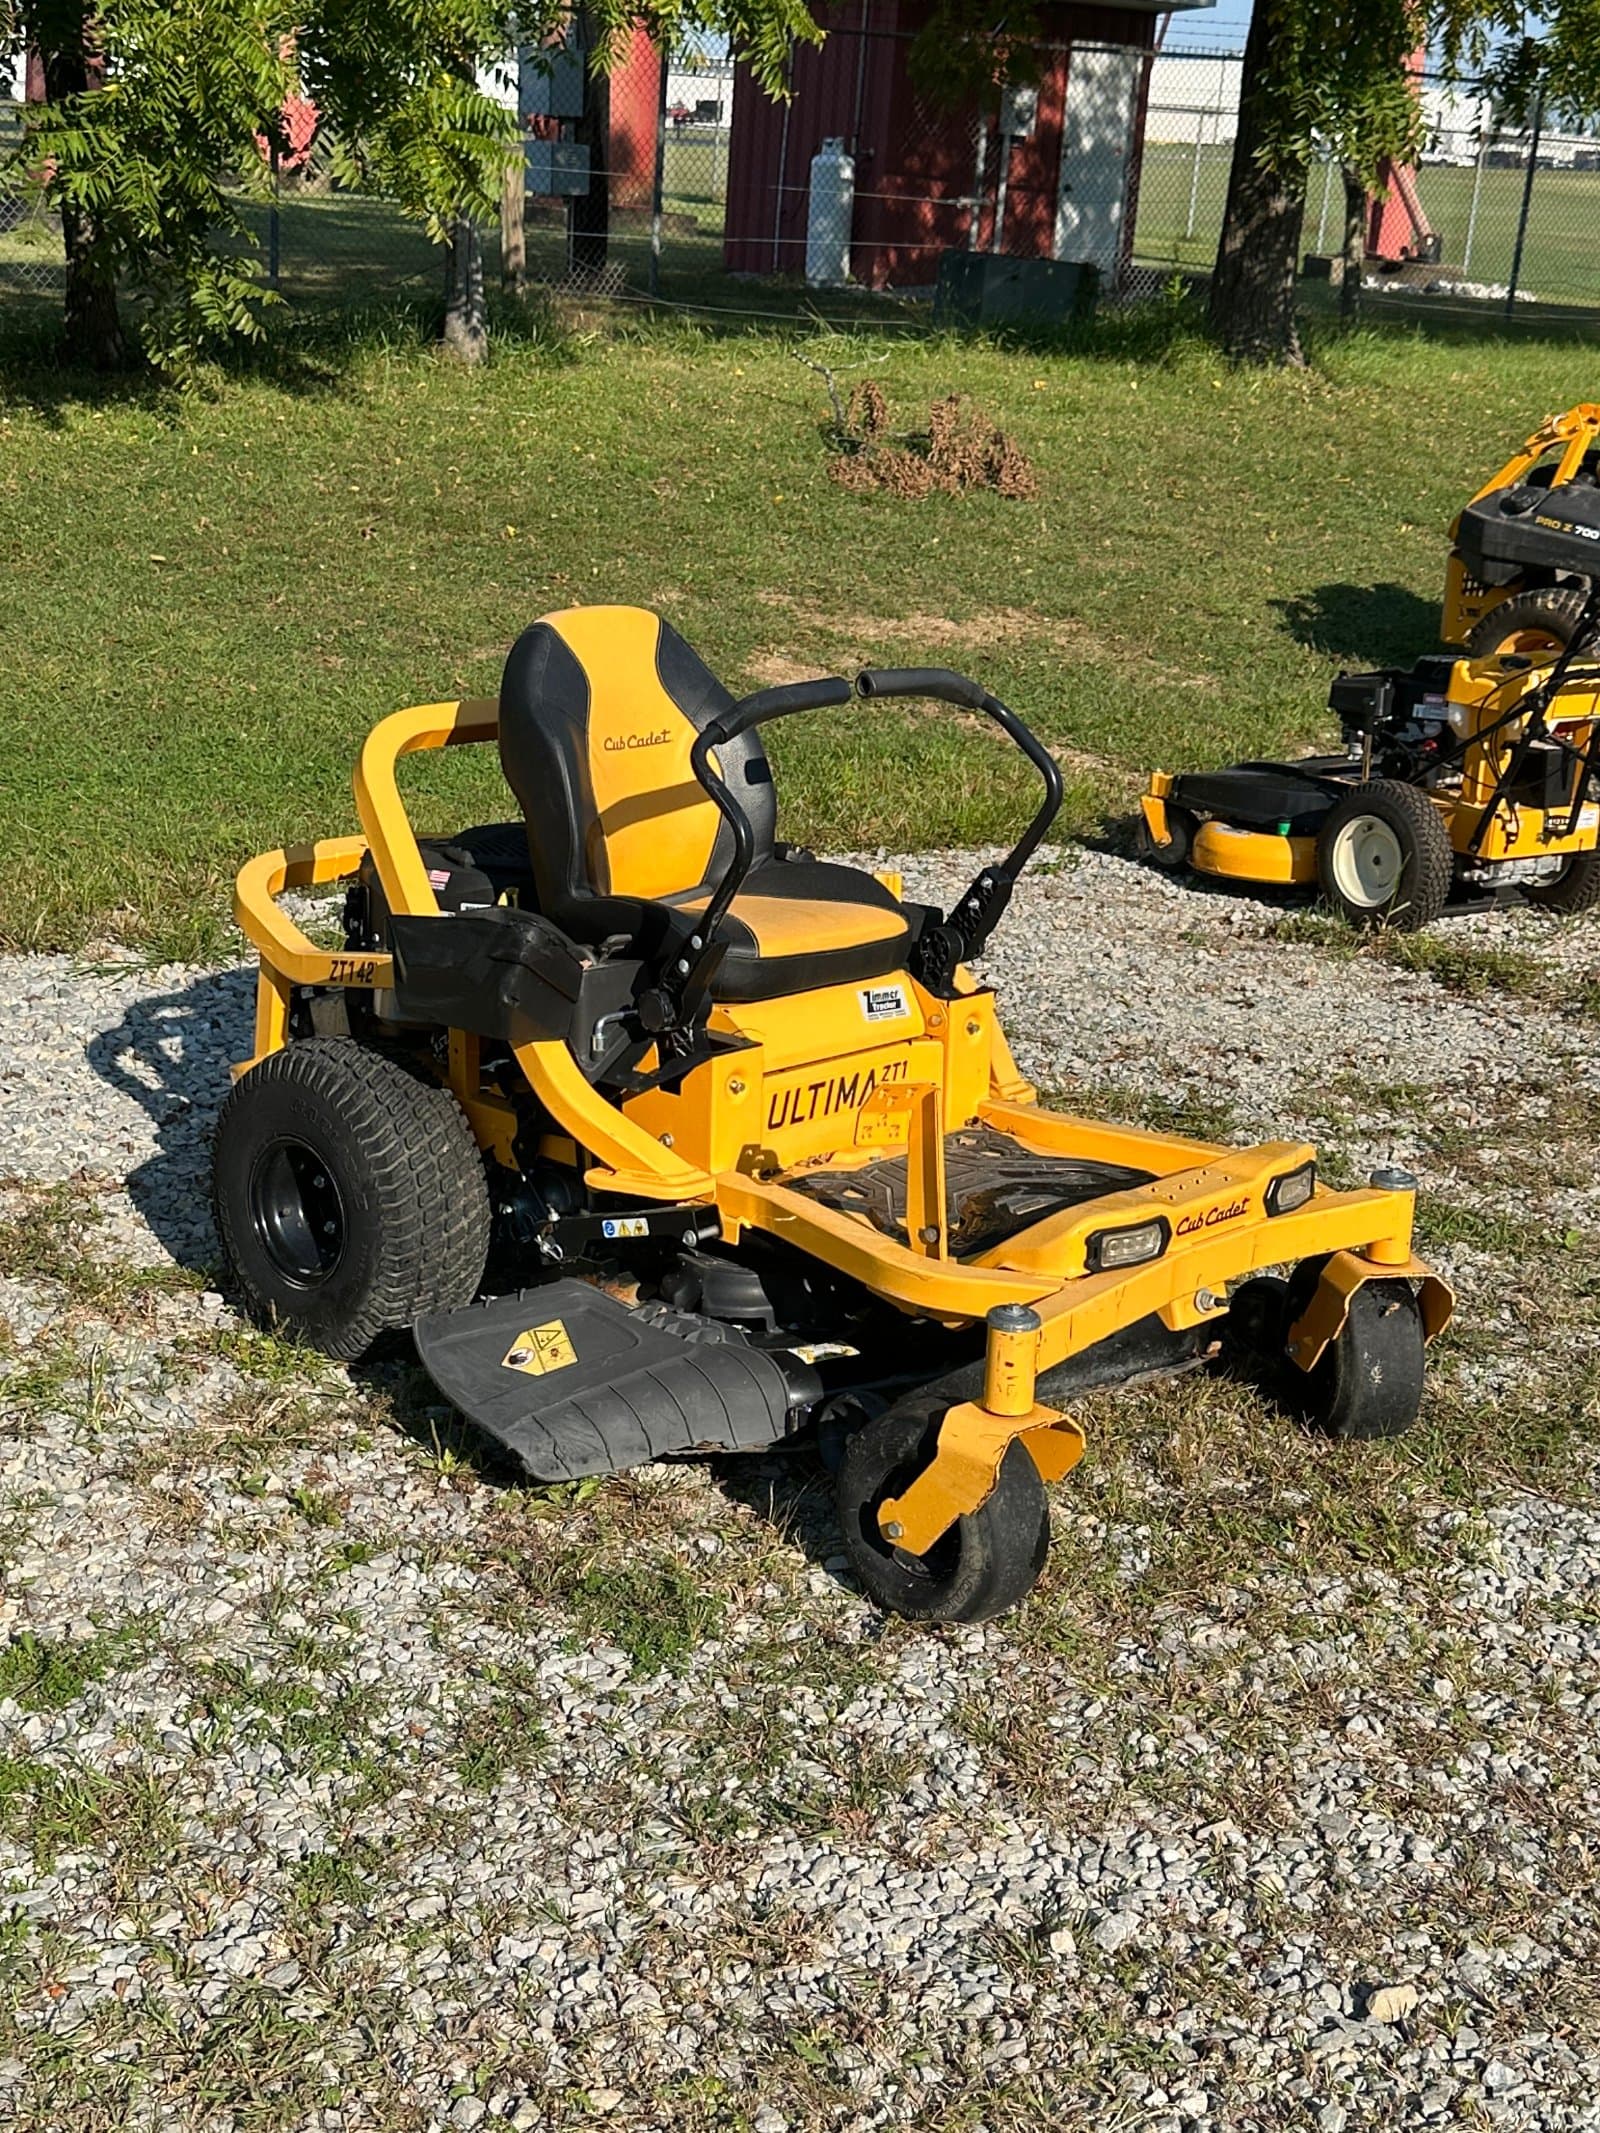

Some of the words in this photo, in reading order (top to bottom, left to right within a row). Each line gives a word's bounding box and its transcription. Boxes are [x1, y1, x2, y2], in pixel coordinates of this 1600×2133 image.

[1535, 514, 1561, 529] PRO
[1563, 522, 1573, 533] Z
[1574, 525, 1600, 540] 700
[604, 736, 626, 751] Cub
[627, 729, 673, 749] Cadet
[329, 960, 355, 982] ZT1
[768, 1068, 876, 1130] ULTIMA
[881, 1060, 908, 1082] ZT1
[1176, 1211, 1204, 1236] Cub
[1205, 1197, 1251, 1226] Cadet
